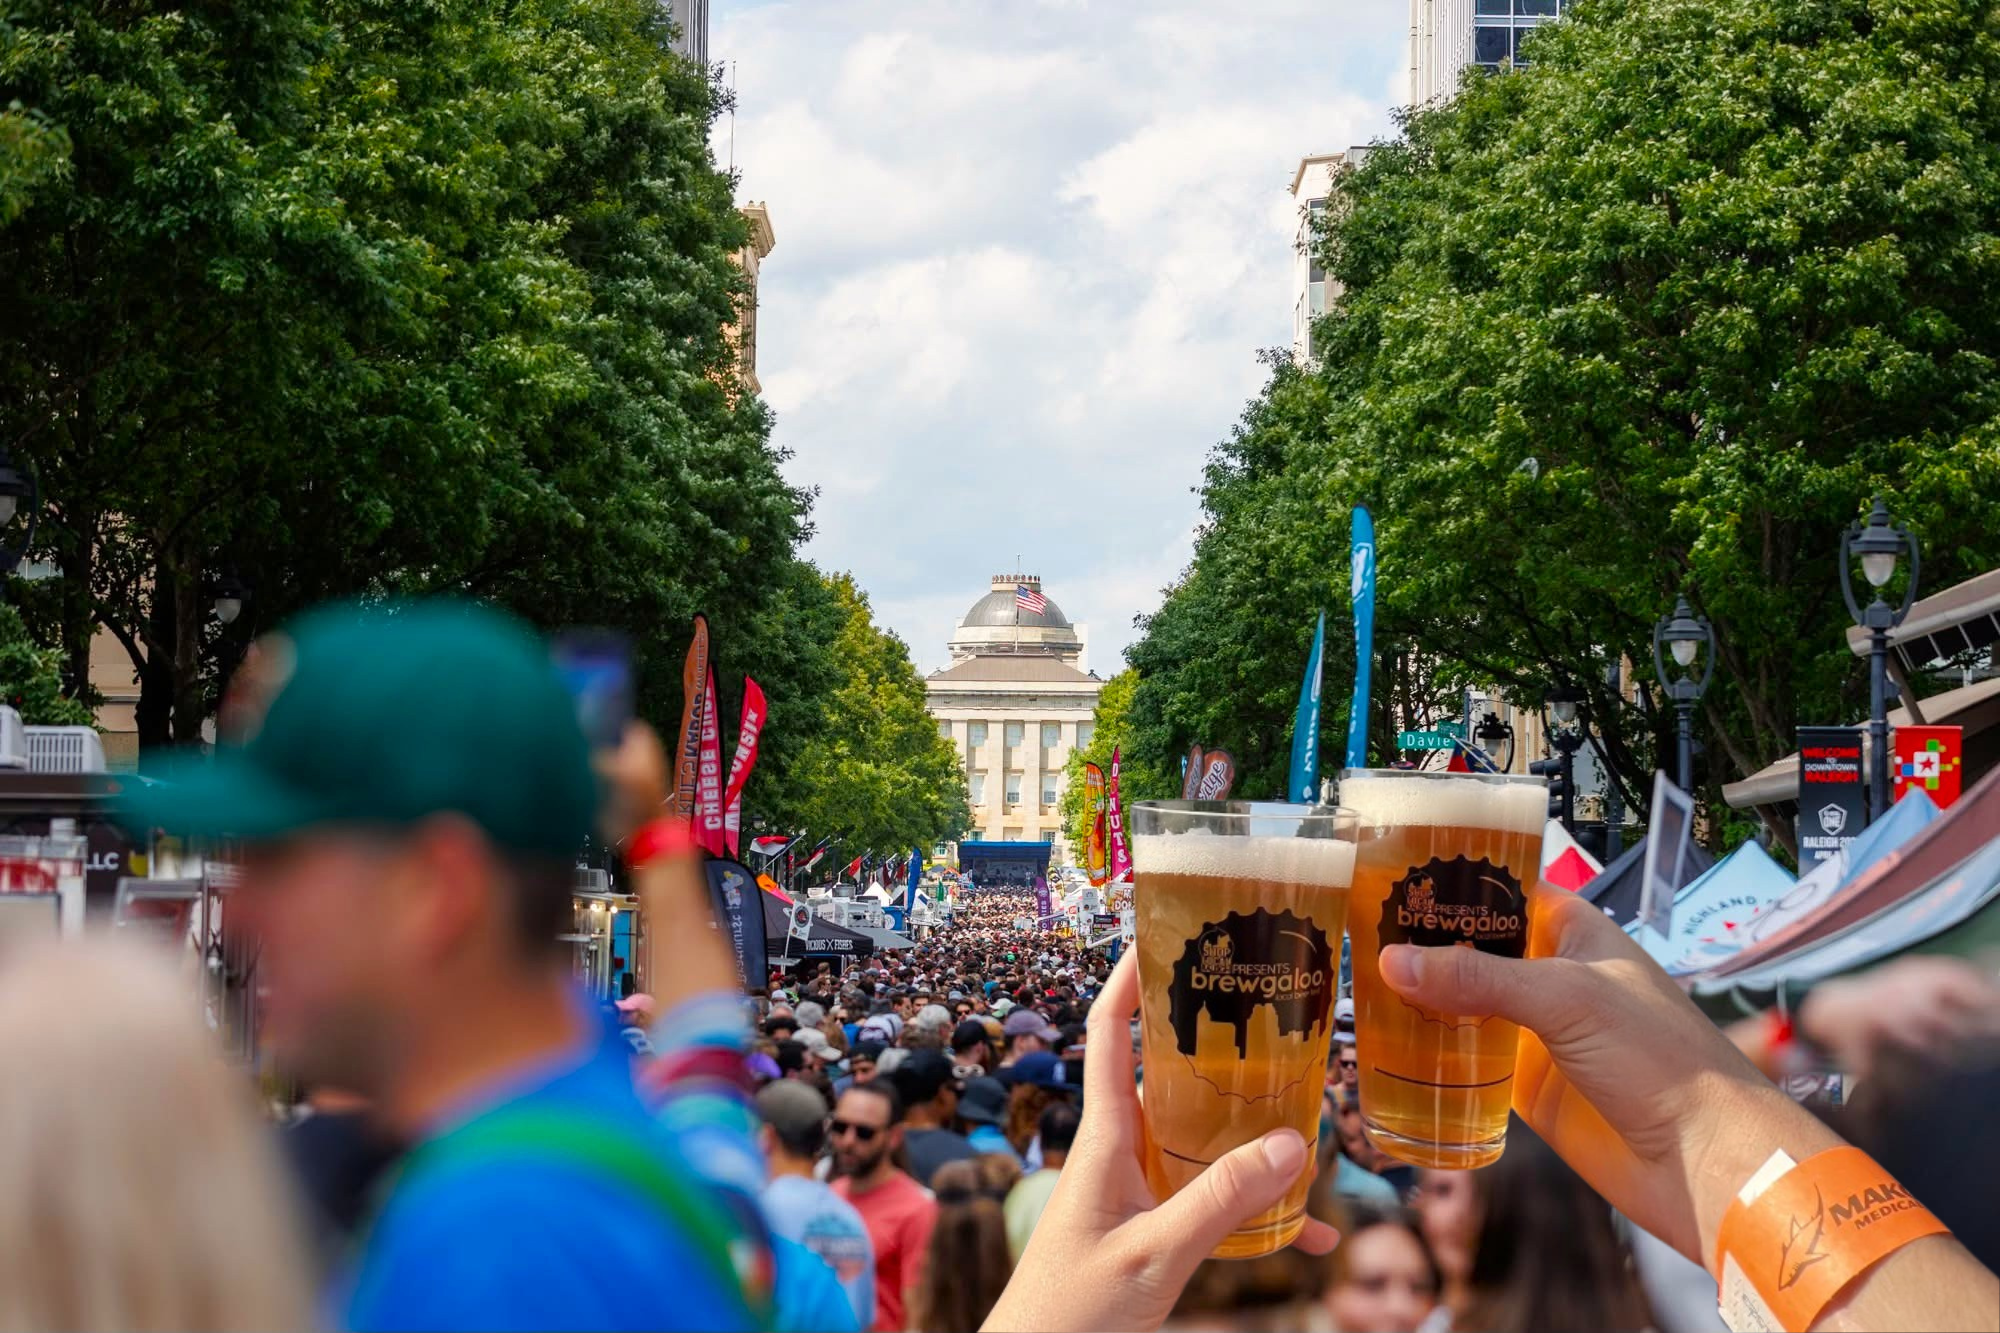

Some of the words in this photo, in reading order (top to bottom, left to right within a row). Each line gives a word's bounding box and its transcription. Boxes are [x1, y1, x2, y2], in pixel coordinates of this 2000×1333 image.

[1407, 734, 1450, 746] Davie
[1804, 763, 1858, 771] DOWNTOWN
[1804, 771, 1859, 783] RALEIGH
[1823, 817, 1841, 827] ONE
[1803, 836, 1839, 848] RALEIGH
[1435, 904, 1488, 916] PRESENTS
[1397, 905, 1519, 936] brewgaloo
[806, 939, 826, 950] VICIOUS
[834, 939, 854, 950] FISHES
[1232, 962, 1290, 975] PRESENTS
[1191, 965, 1324, 999] brewgaloo
